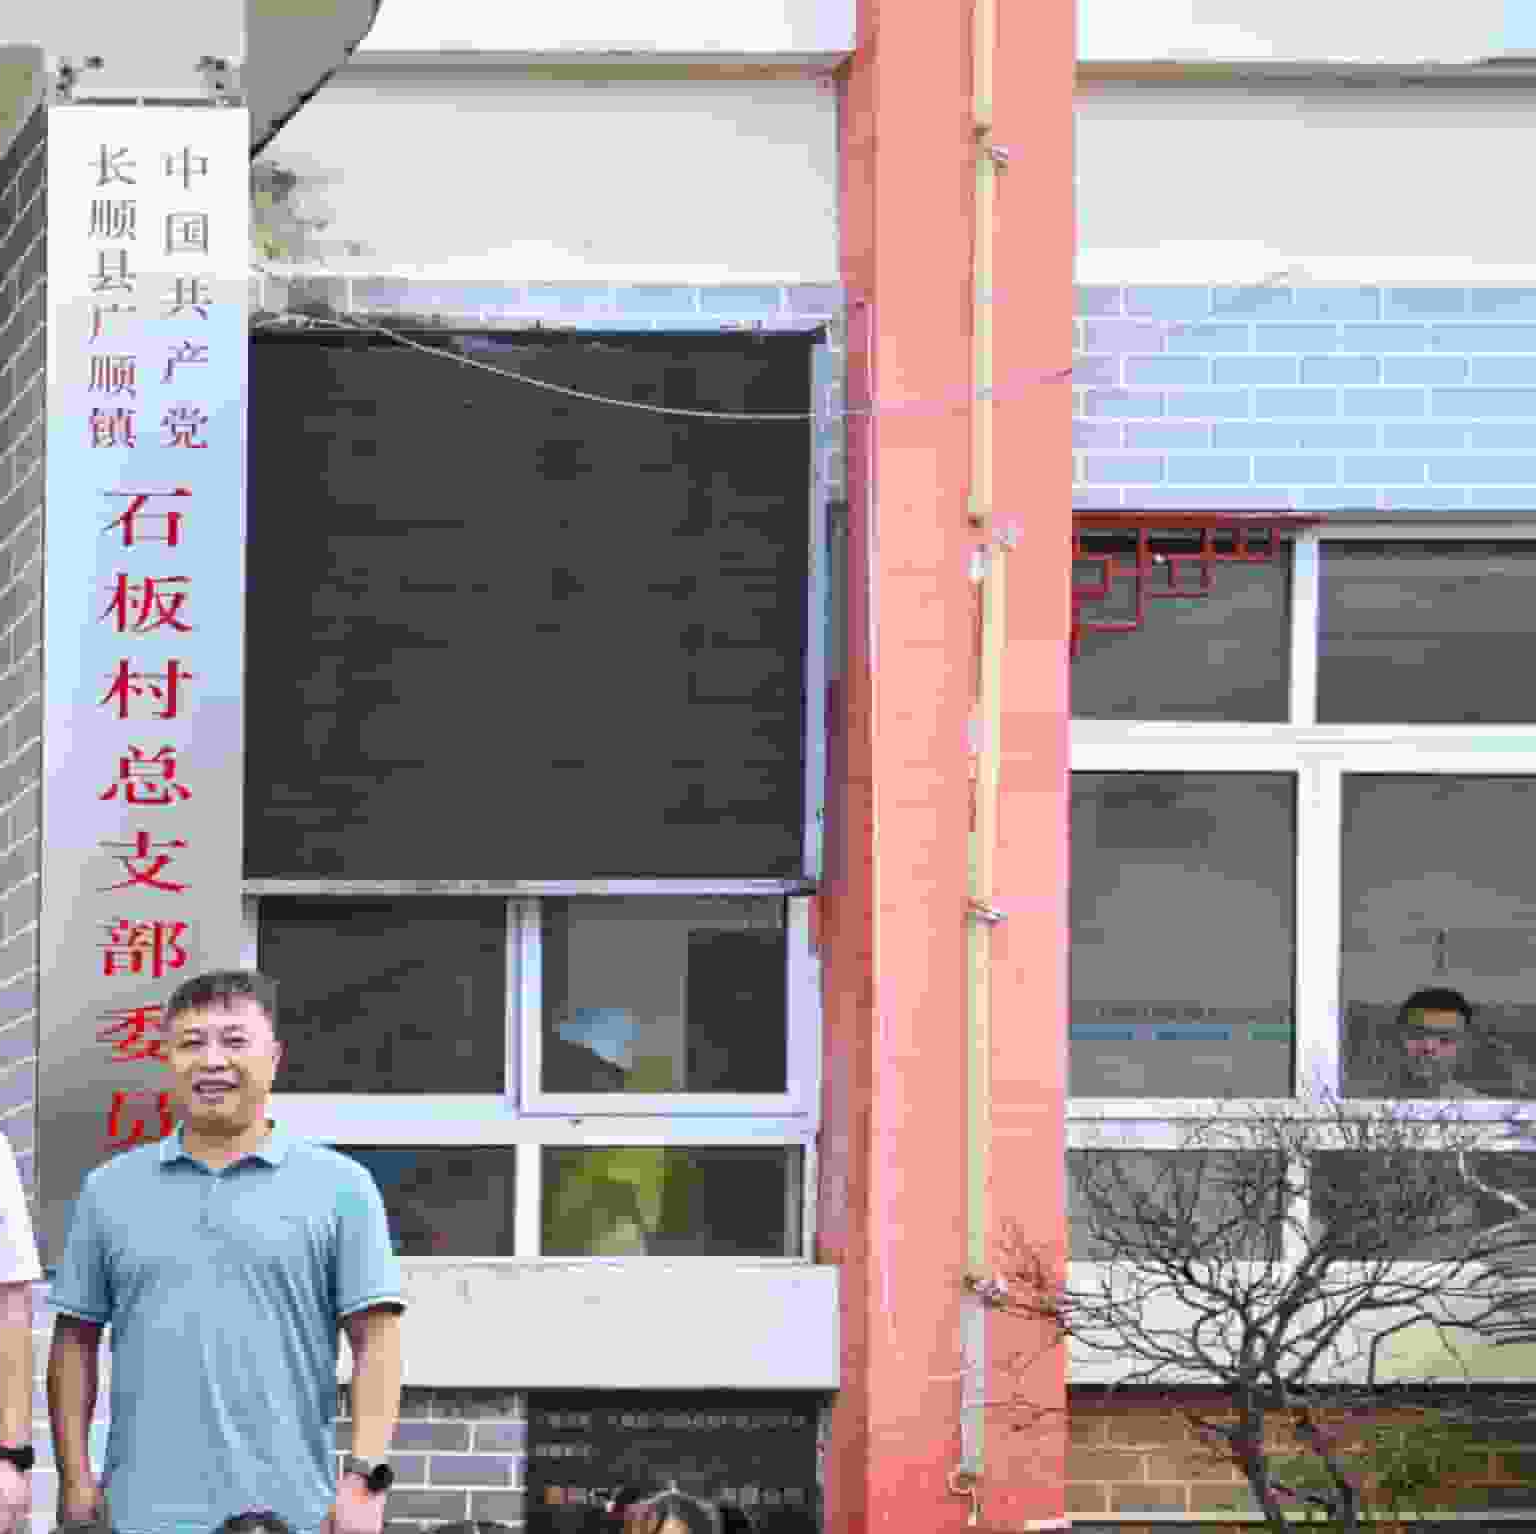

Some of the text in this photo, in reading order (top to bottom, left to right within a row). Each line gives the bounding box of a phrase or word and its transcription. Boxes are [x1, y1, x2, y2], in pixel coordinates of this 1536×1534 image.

[87, 143, 138, 449] 长顺县广顺镇
[160, 145, 211, 449] 中国共产党
